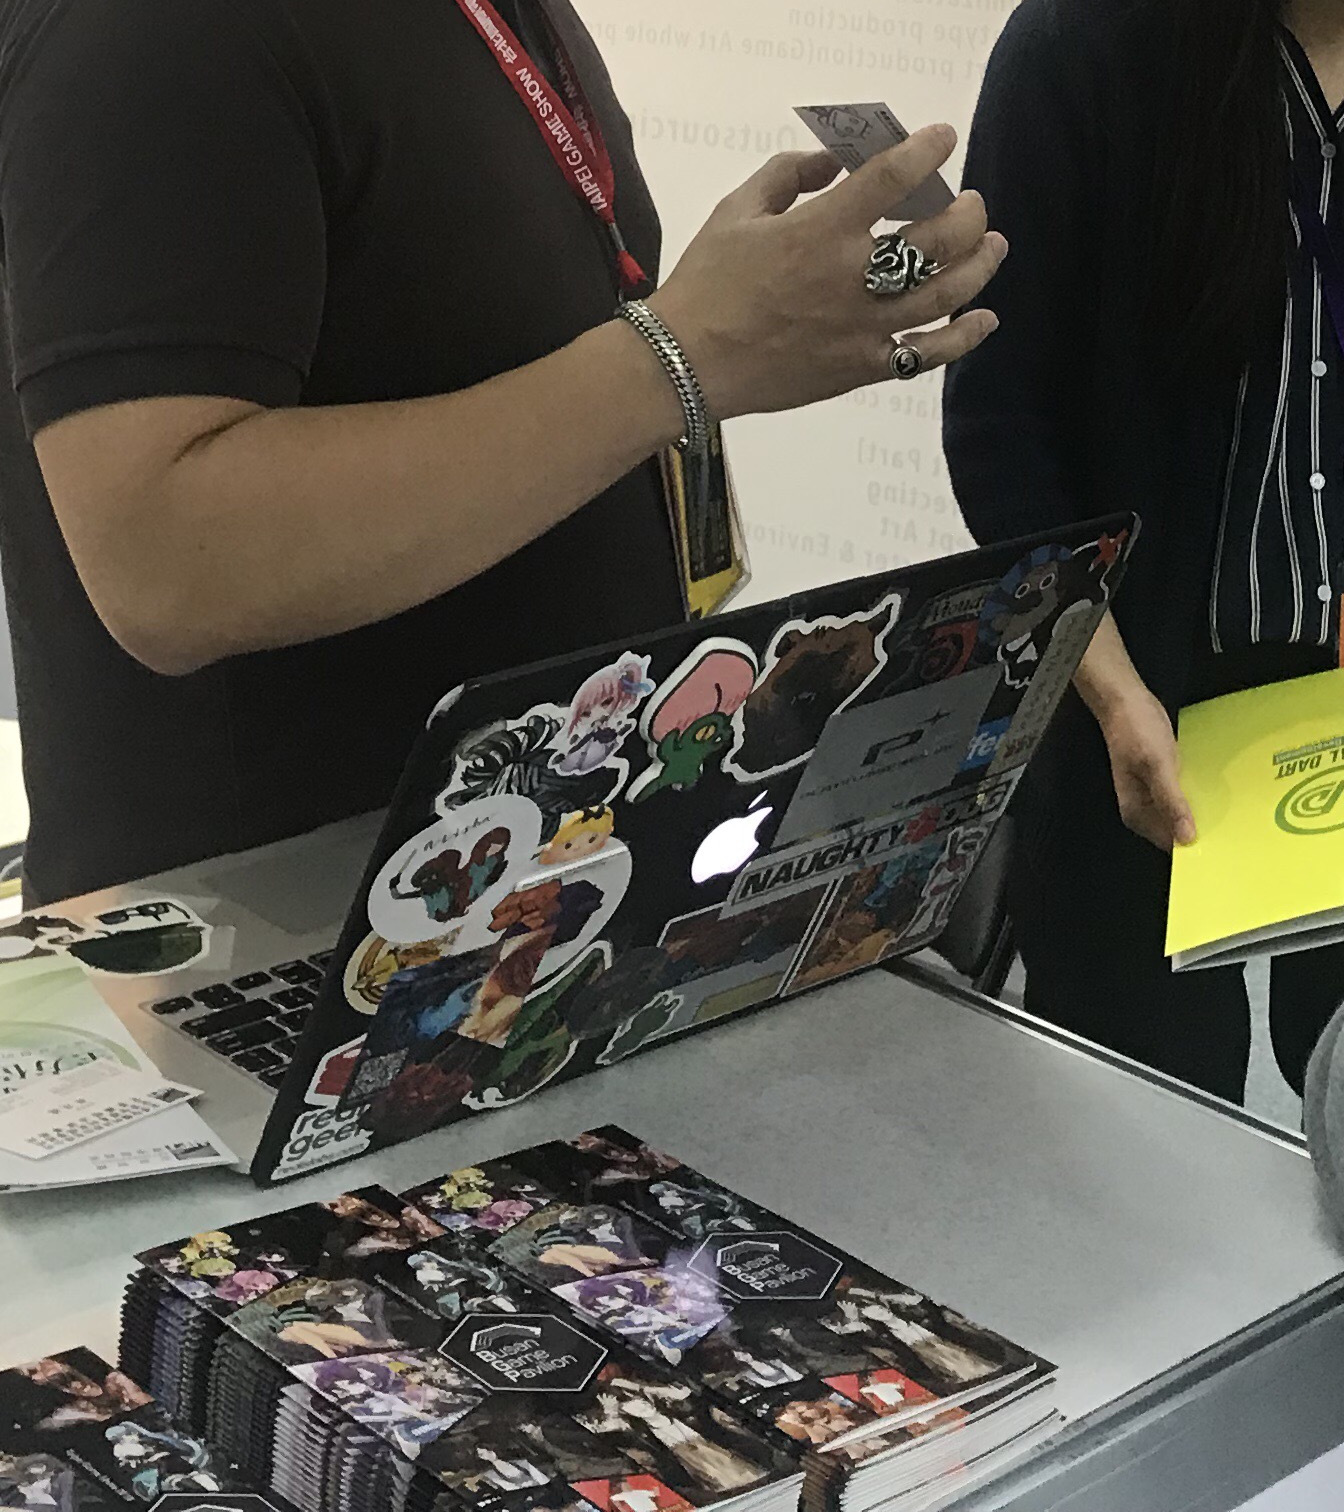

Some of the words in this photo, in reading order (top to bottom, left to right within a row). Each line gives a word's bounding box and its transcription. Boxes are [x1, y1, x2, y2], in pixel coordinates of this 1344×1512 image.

[515, 66, 553, 119] SHOW
[572, 164, 608, 213] TAIPEI
[1274, 754, 1323, 780] DART
[739, 822, 906, 899] NAUGHTY
[475, 1338, 541, 1363] Busan
[490, 1349, 550, 1372] Game
[503, 1354, 578, 1383] Pavilion
